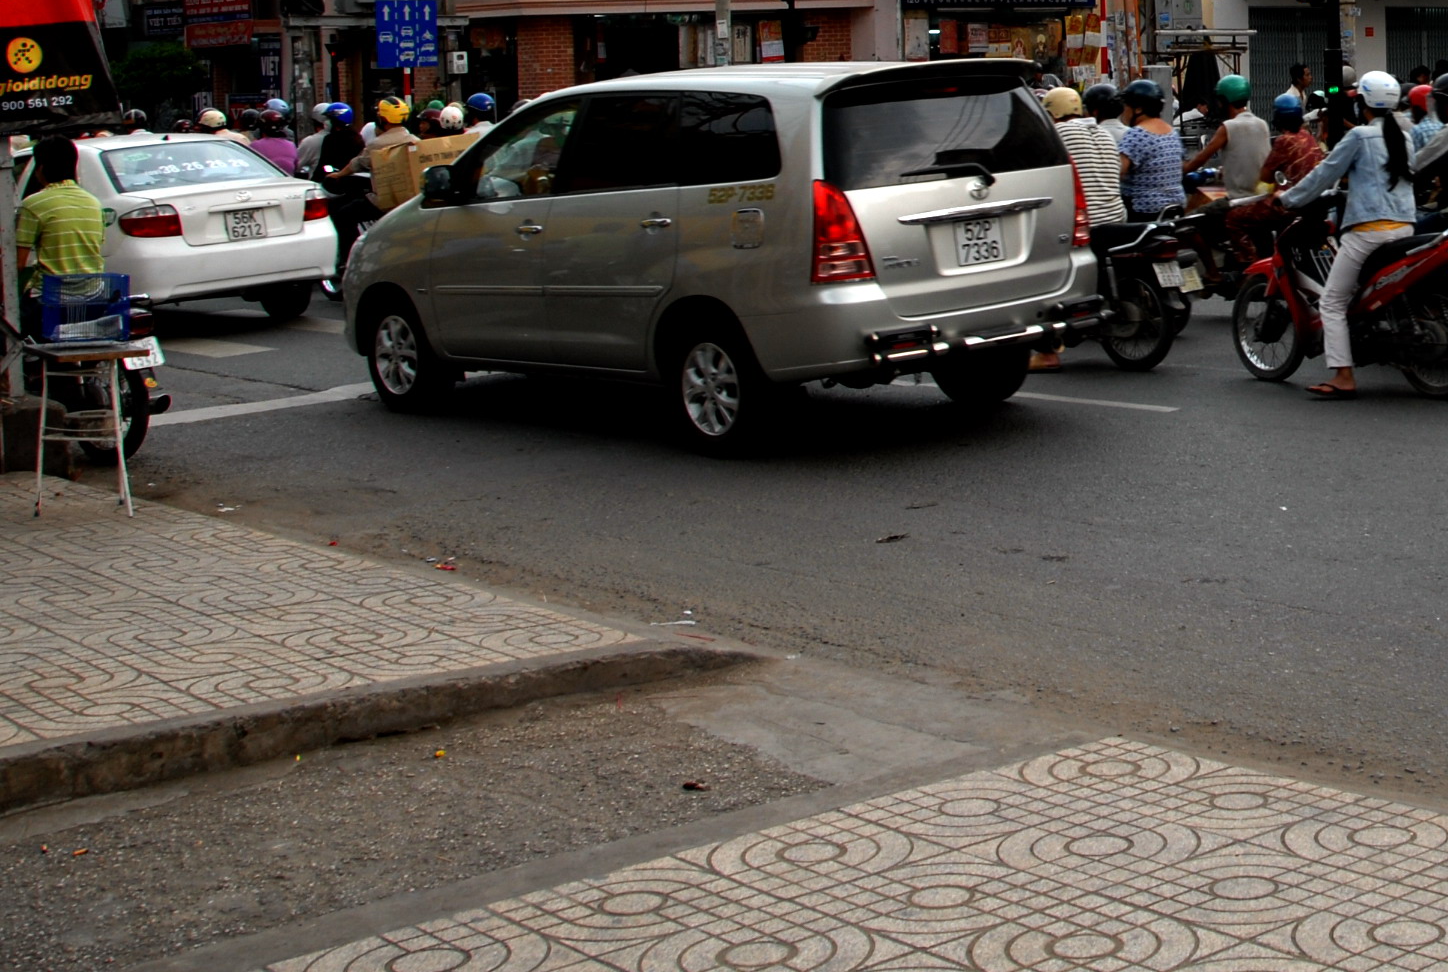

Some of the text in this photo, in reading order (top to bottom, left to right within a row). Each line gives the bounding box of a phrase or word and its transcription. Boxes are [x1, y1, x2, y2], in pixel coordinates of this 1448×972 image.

[28, 98, 48, 109] 561
[52, 95, 74, 106] 292
[233, 210, 257, 225] 56K
[231, 223, 263, 239] 6212
[964, 220, 993, 242] 52P
[961, 240, 1001, 264] 7336
